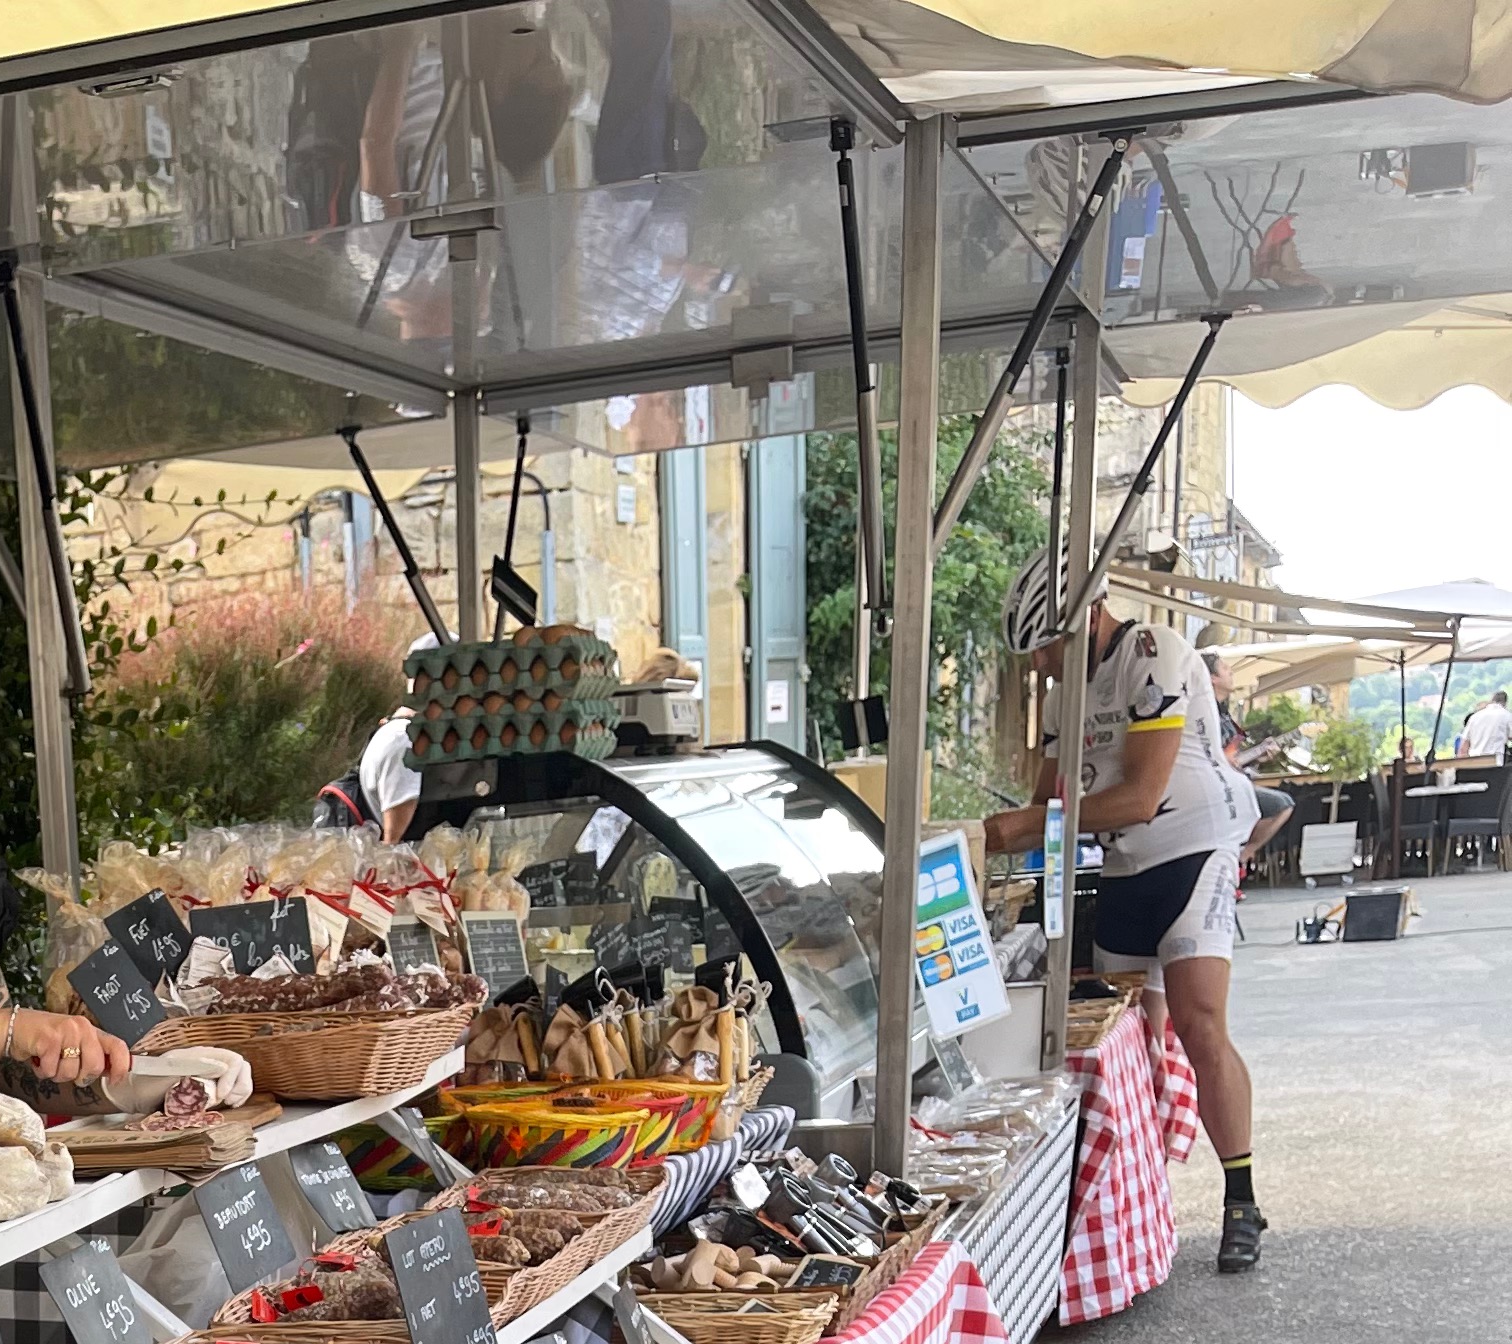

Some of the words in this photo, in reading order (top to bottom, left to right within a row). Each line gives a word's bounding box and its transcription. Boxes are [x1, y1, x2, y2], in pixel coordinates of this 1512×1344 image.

[949, 914, 977, 934] VISA
[958, 941, 986, 963] VISA
[93, 974, 121, 1004] FAGOT
[66, 1274, 101, 1308] OLIVE
